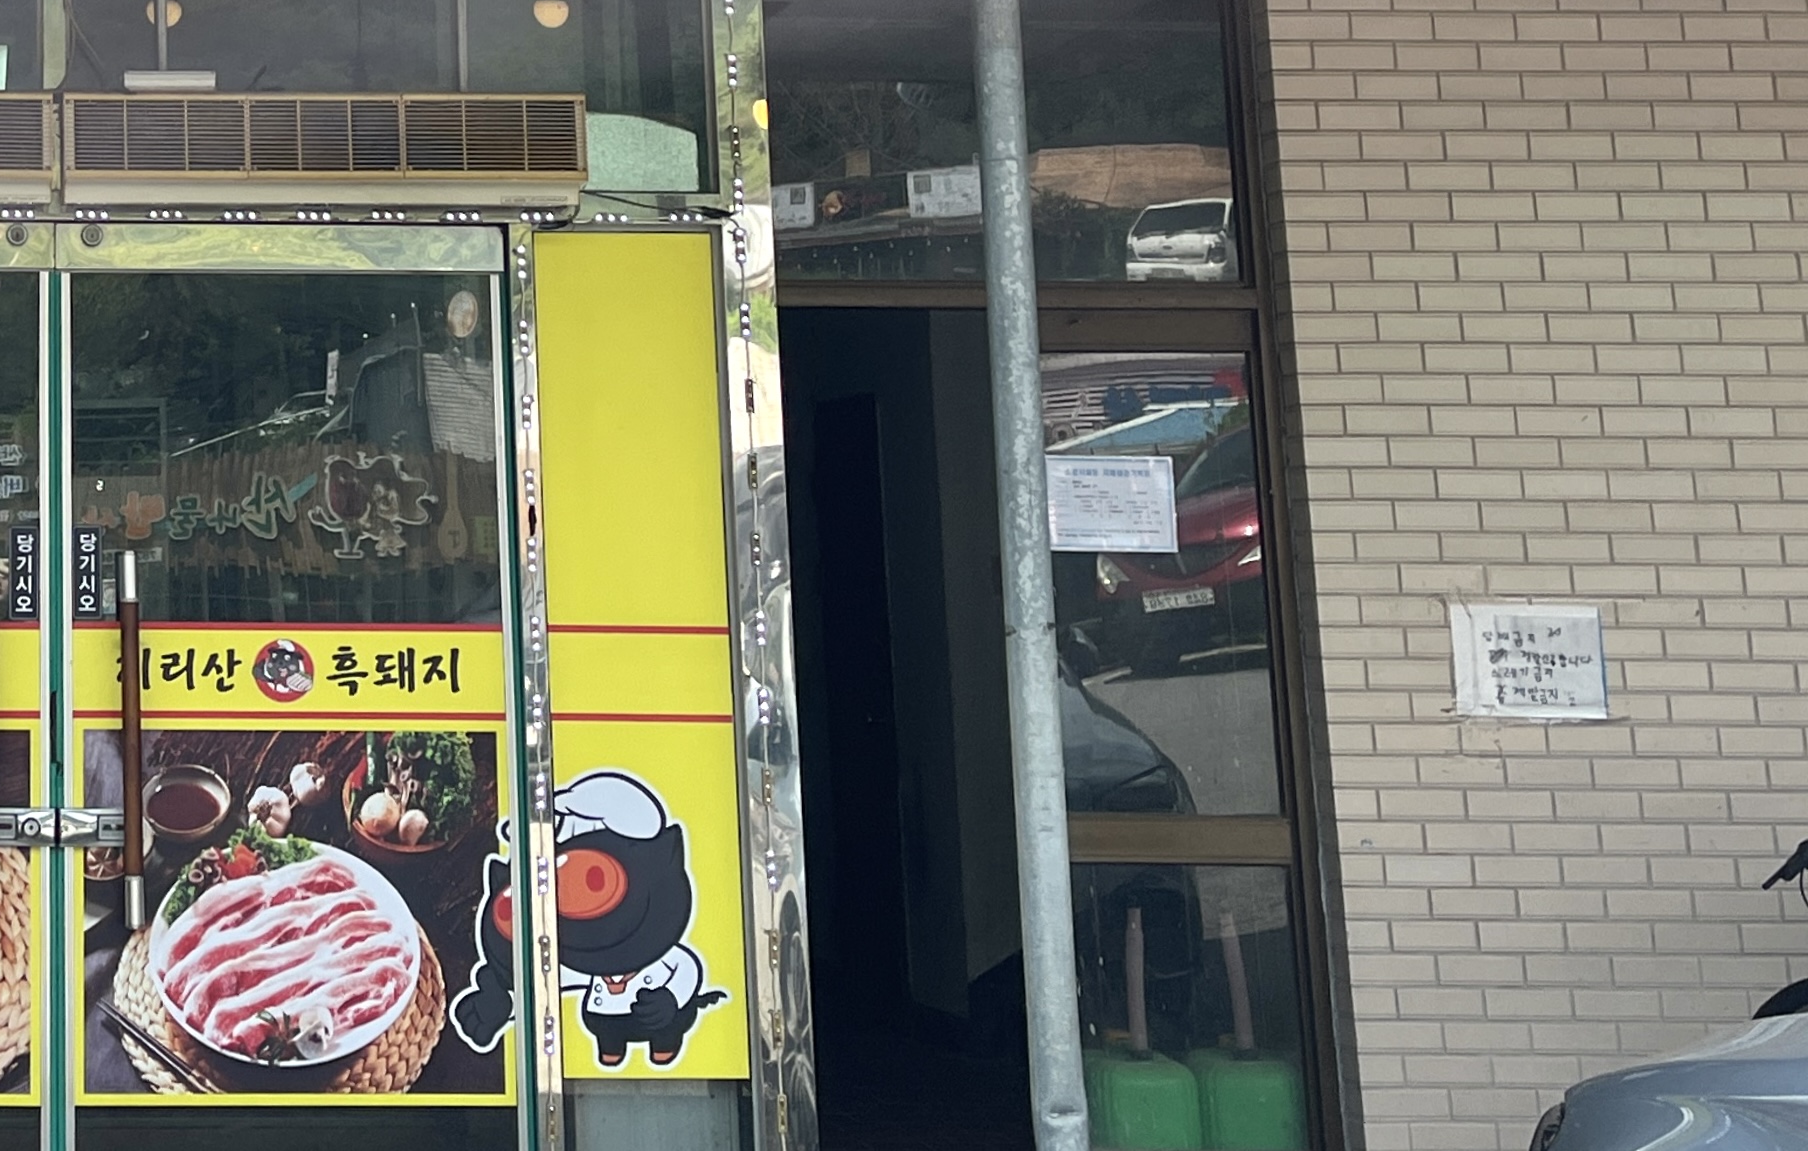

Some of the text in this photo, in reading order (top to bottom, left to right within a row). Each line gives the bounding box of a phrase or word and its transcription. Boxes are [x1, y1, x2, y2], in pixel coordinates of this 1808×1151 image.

[15, 534, 35, 613] 당기시오
[78, 533, 98, 612] 당기시오
[325, 646, 461, 697] 흑돼지
